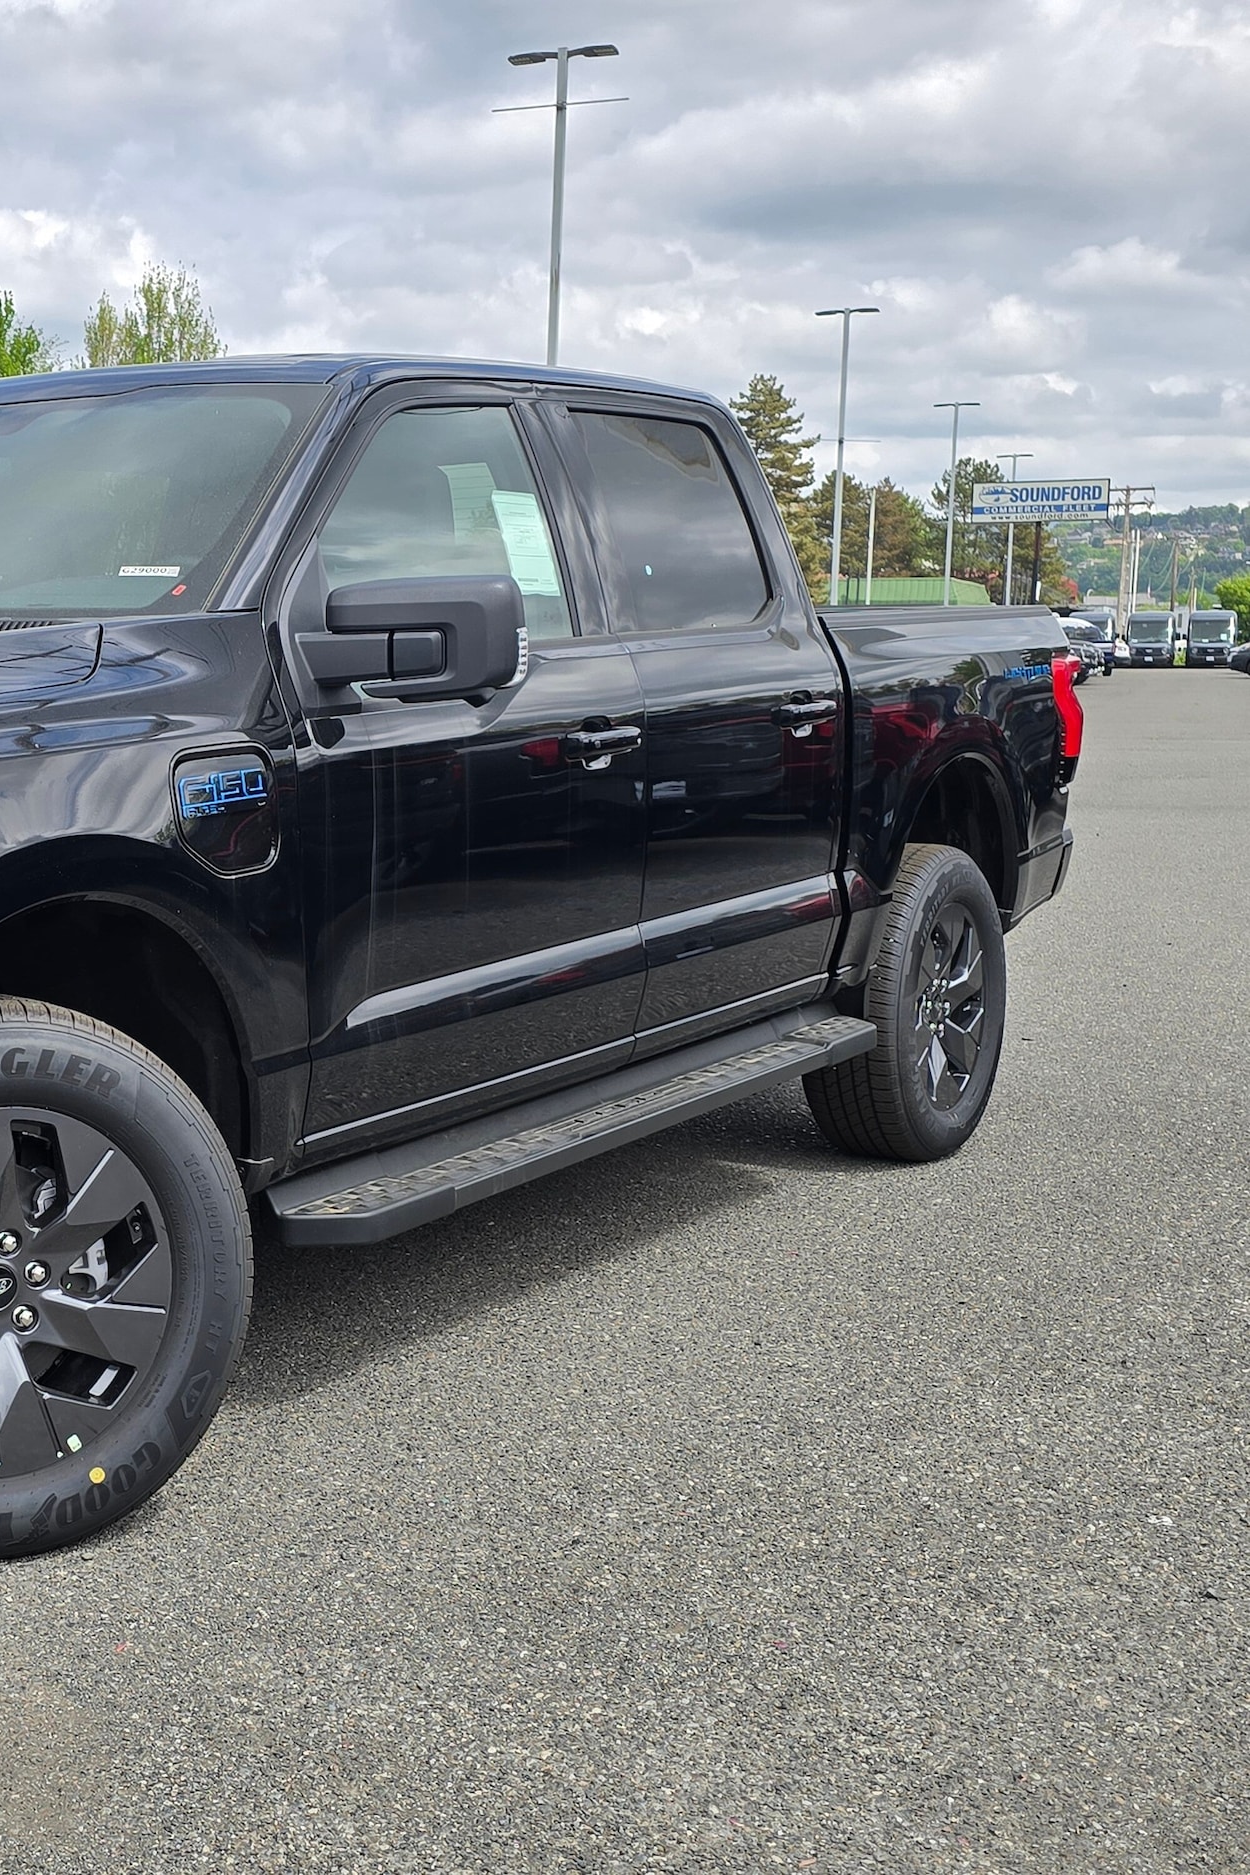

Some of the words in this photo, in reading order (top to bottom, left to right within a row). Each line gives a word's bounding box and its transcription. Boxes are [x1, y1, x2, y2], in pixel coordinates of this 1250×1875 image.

[983, 506, 1057, 514] COMMERCIAL
[1062, 504, 1097, 512] FLEET
[990, 512, 1089, 520] www.soundford.com
[184, 1153, 227, 1302] TERRITORY
